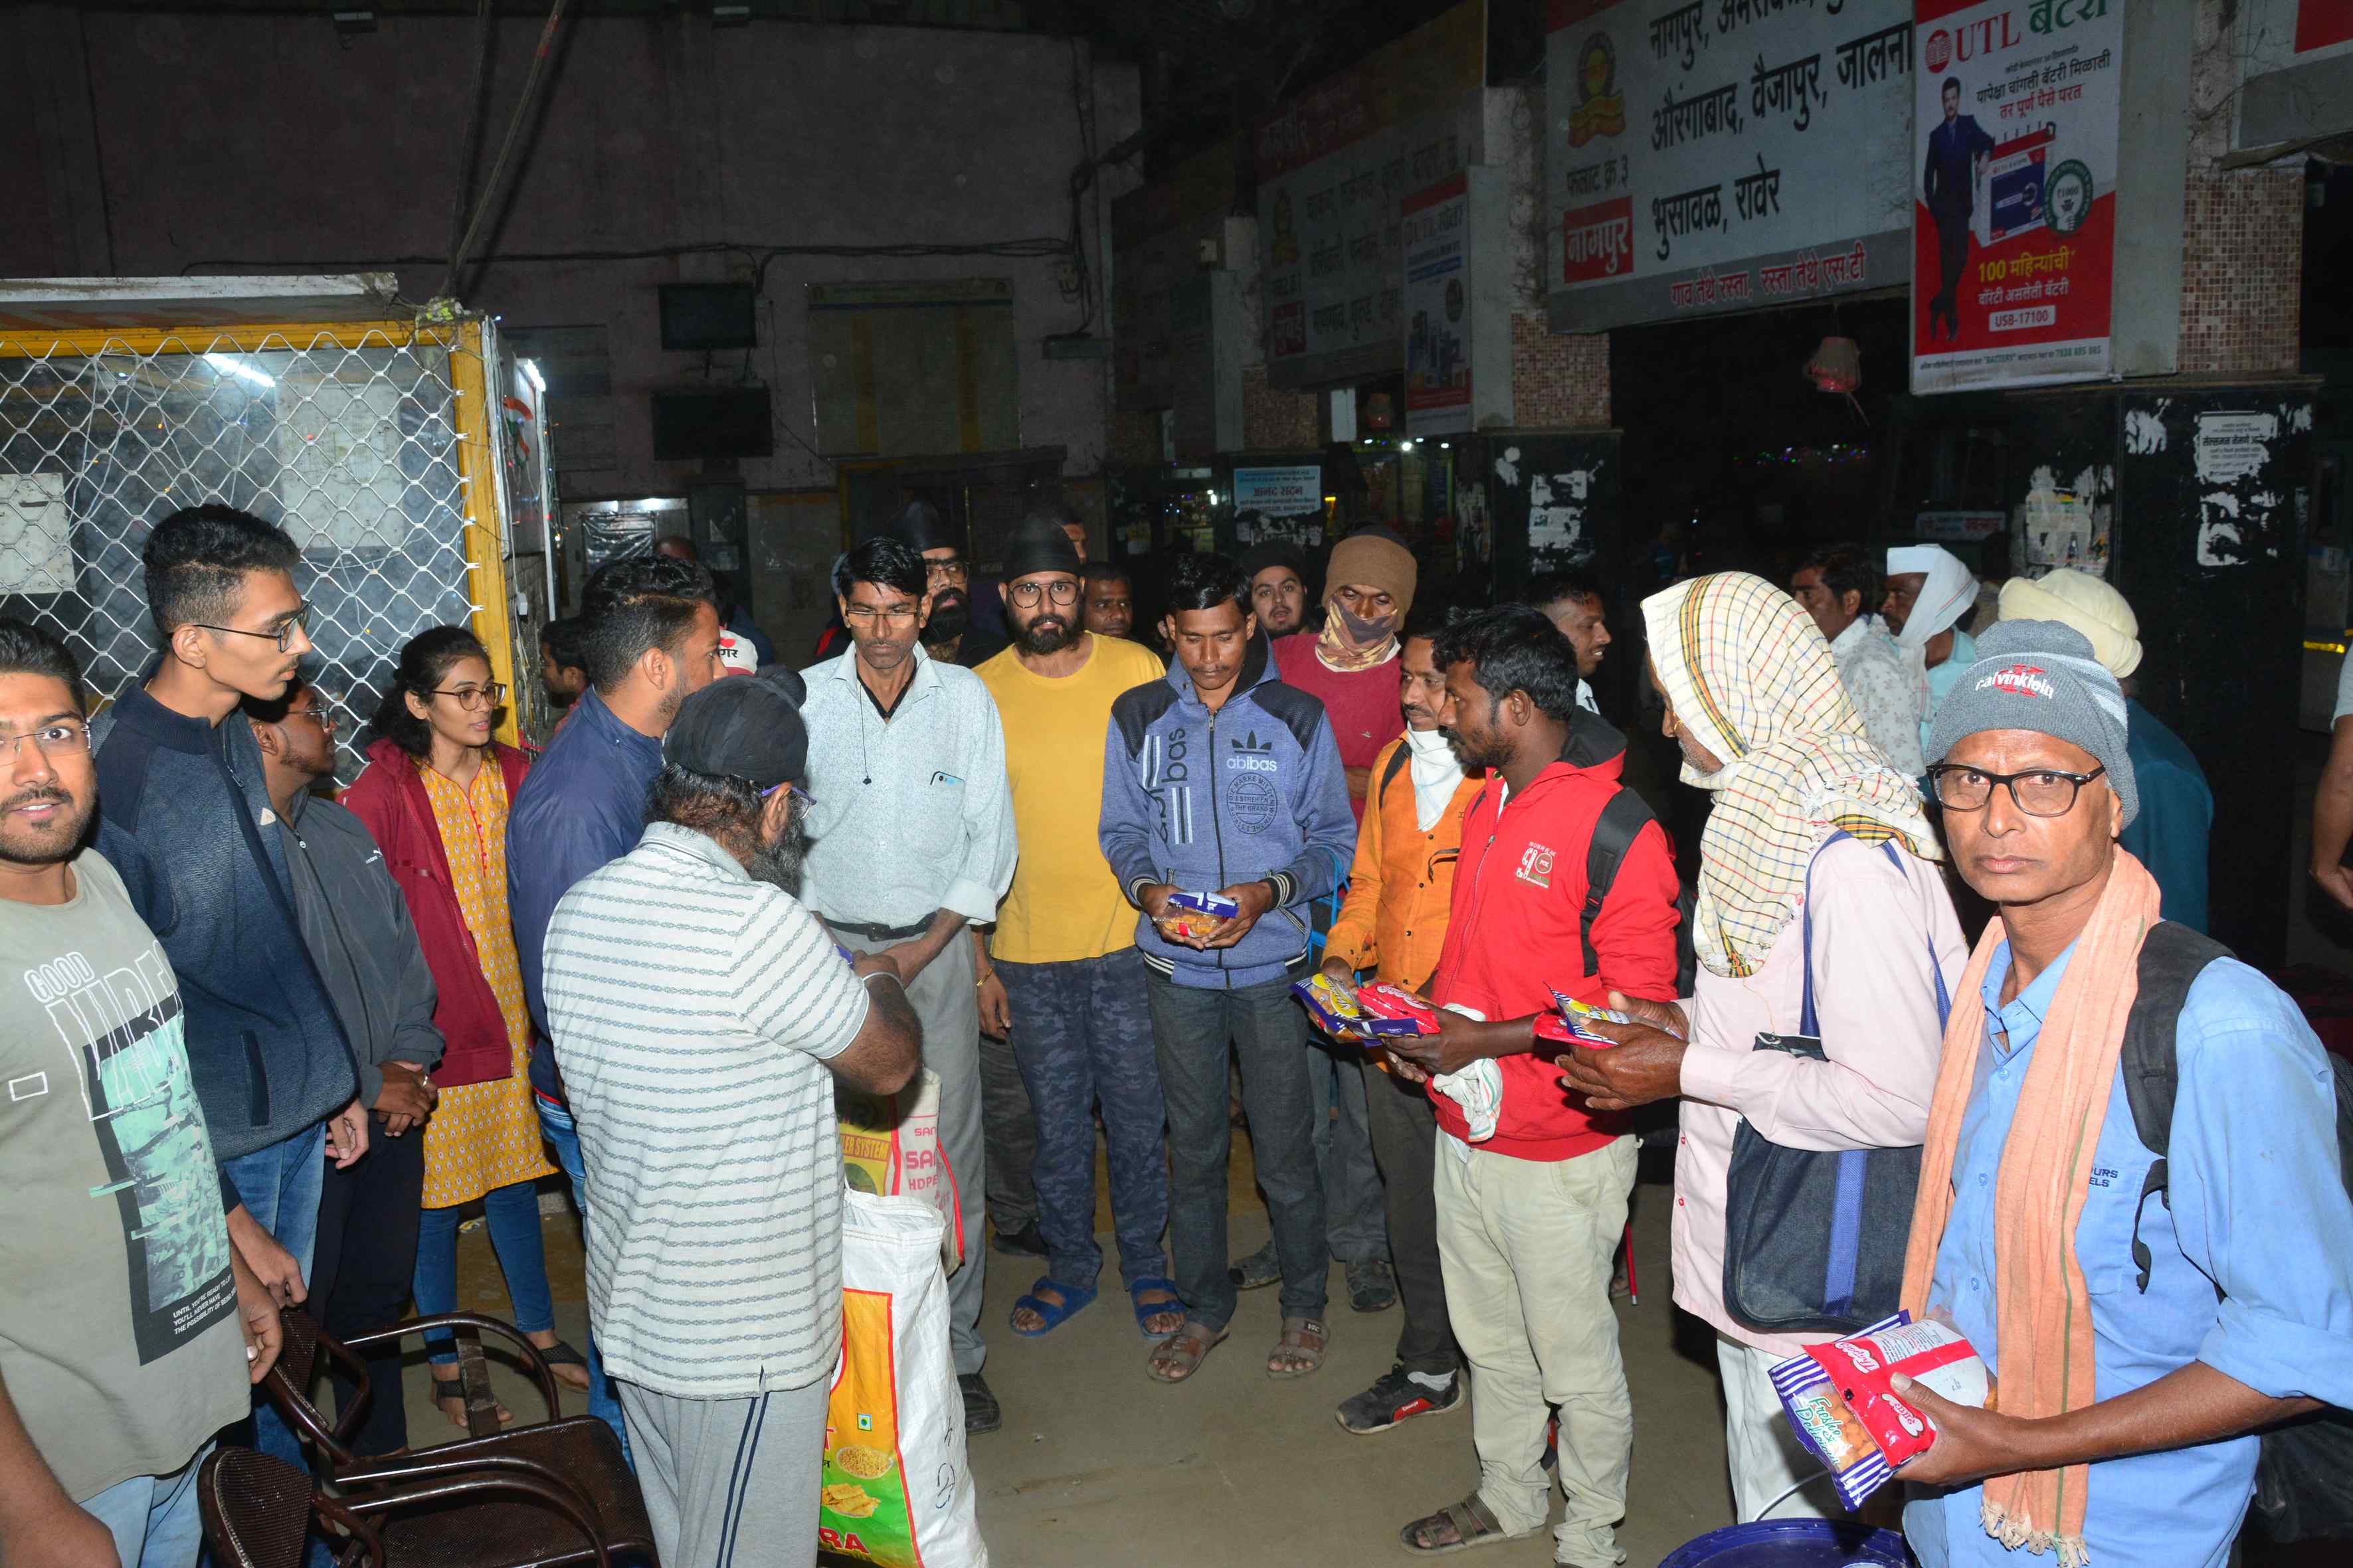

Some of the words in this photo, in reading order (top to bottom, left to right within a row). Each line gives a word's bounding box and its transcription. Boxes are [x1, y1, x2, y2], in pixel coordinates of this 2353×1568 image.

[1955, 11, 2020, 62] UTL
[2008, 70, 2039, 96] चांगली
[2000, 103, 2014, 118] तर
[2037, 86, 2057, 108] पैसे
[2059, 84, 2085, 102] परत
[1735, 153, 1780, 220] रावेर
[1568, 217, 1629, 274] नागपुर
[1978, 258, 2006, 283] 100
[720, 648, 739, 658] गर
[1227, 755, 1277, 772] abibas
[24, 951, 95, 1003] GOOD
[854, 1137, 888, 1159] SYSTEM
[2091, 1168, 2118, 1178] URS
[173, 1306, 191, 1318] UNTIL
[174, 1324, 187, 1335] THE
